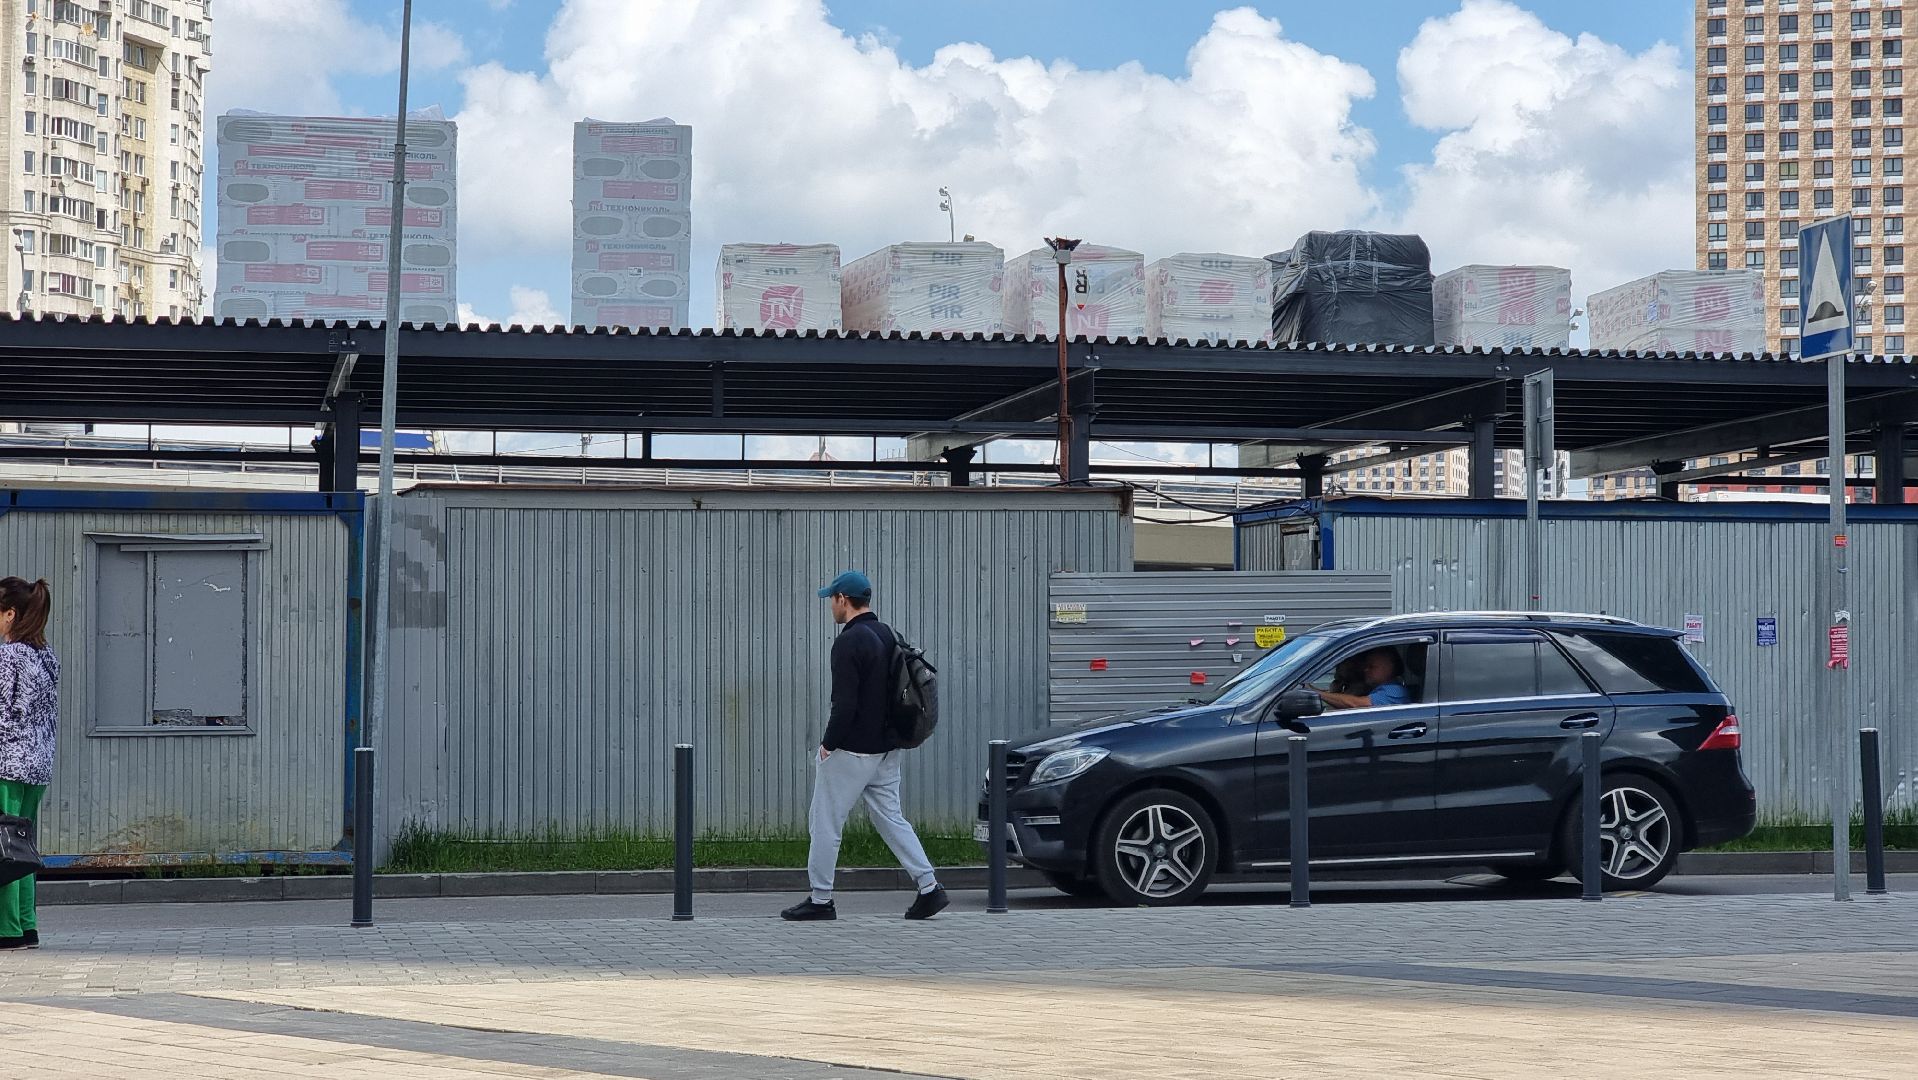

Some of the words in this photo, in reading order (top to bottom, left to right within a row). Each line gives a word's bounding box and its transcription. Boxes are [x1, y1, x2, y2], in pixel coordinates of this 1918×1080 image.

[605, 204, 670, 213] ТЕХНОНИКОЛЬ
[931, 252, 963, 266] PIR
[929, 283, 961, 299] PIR
[930, 304, 963, 319] PIR
